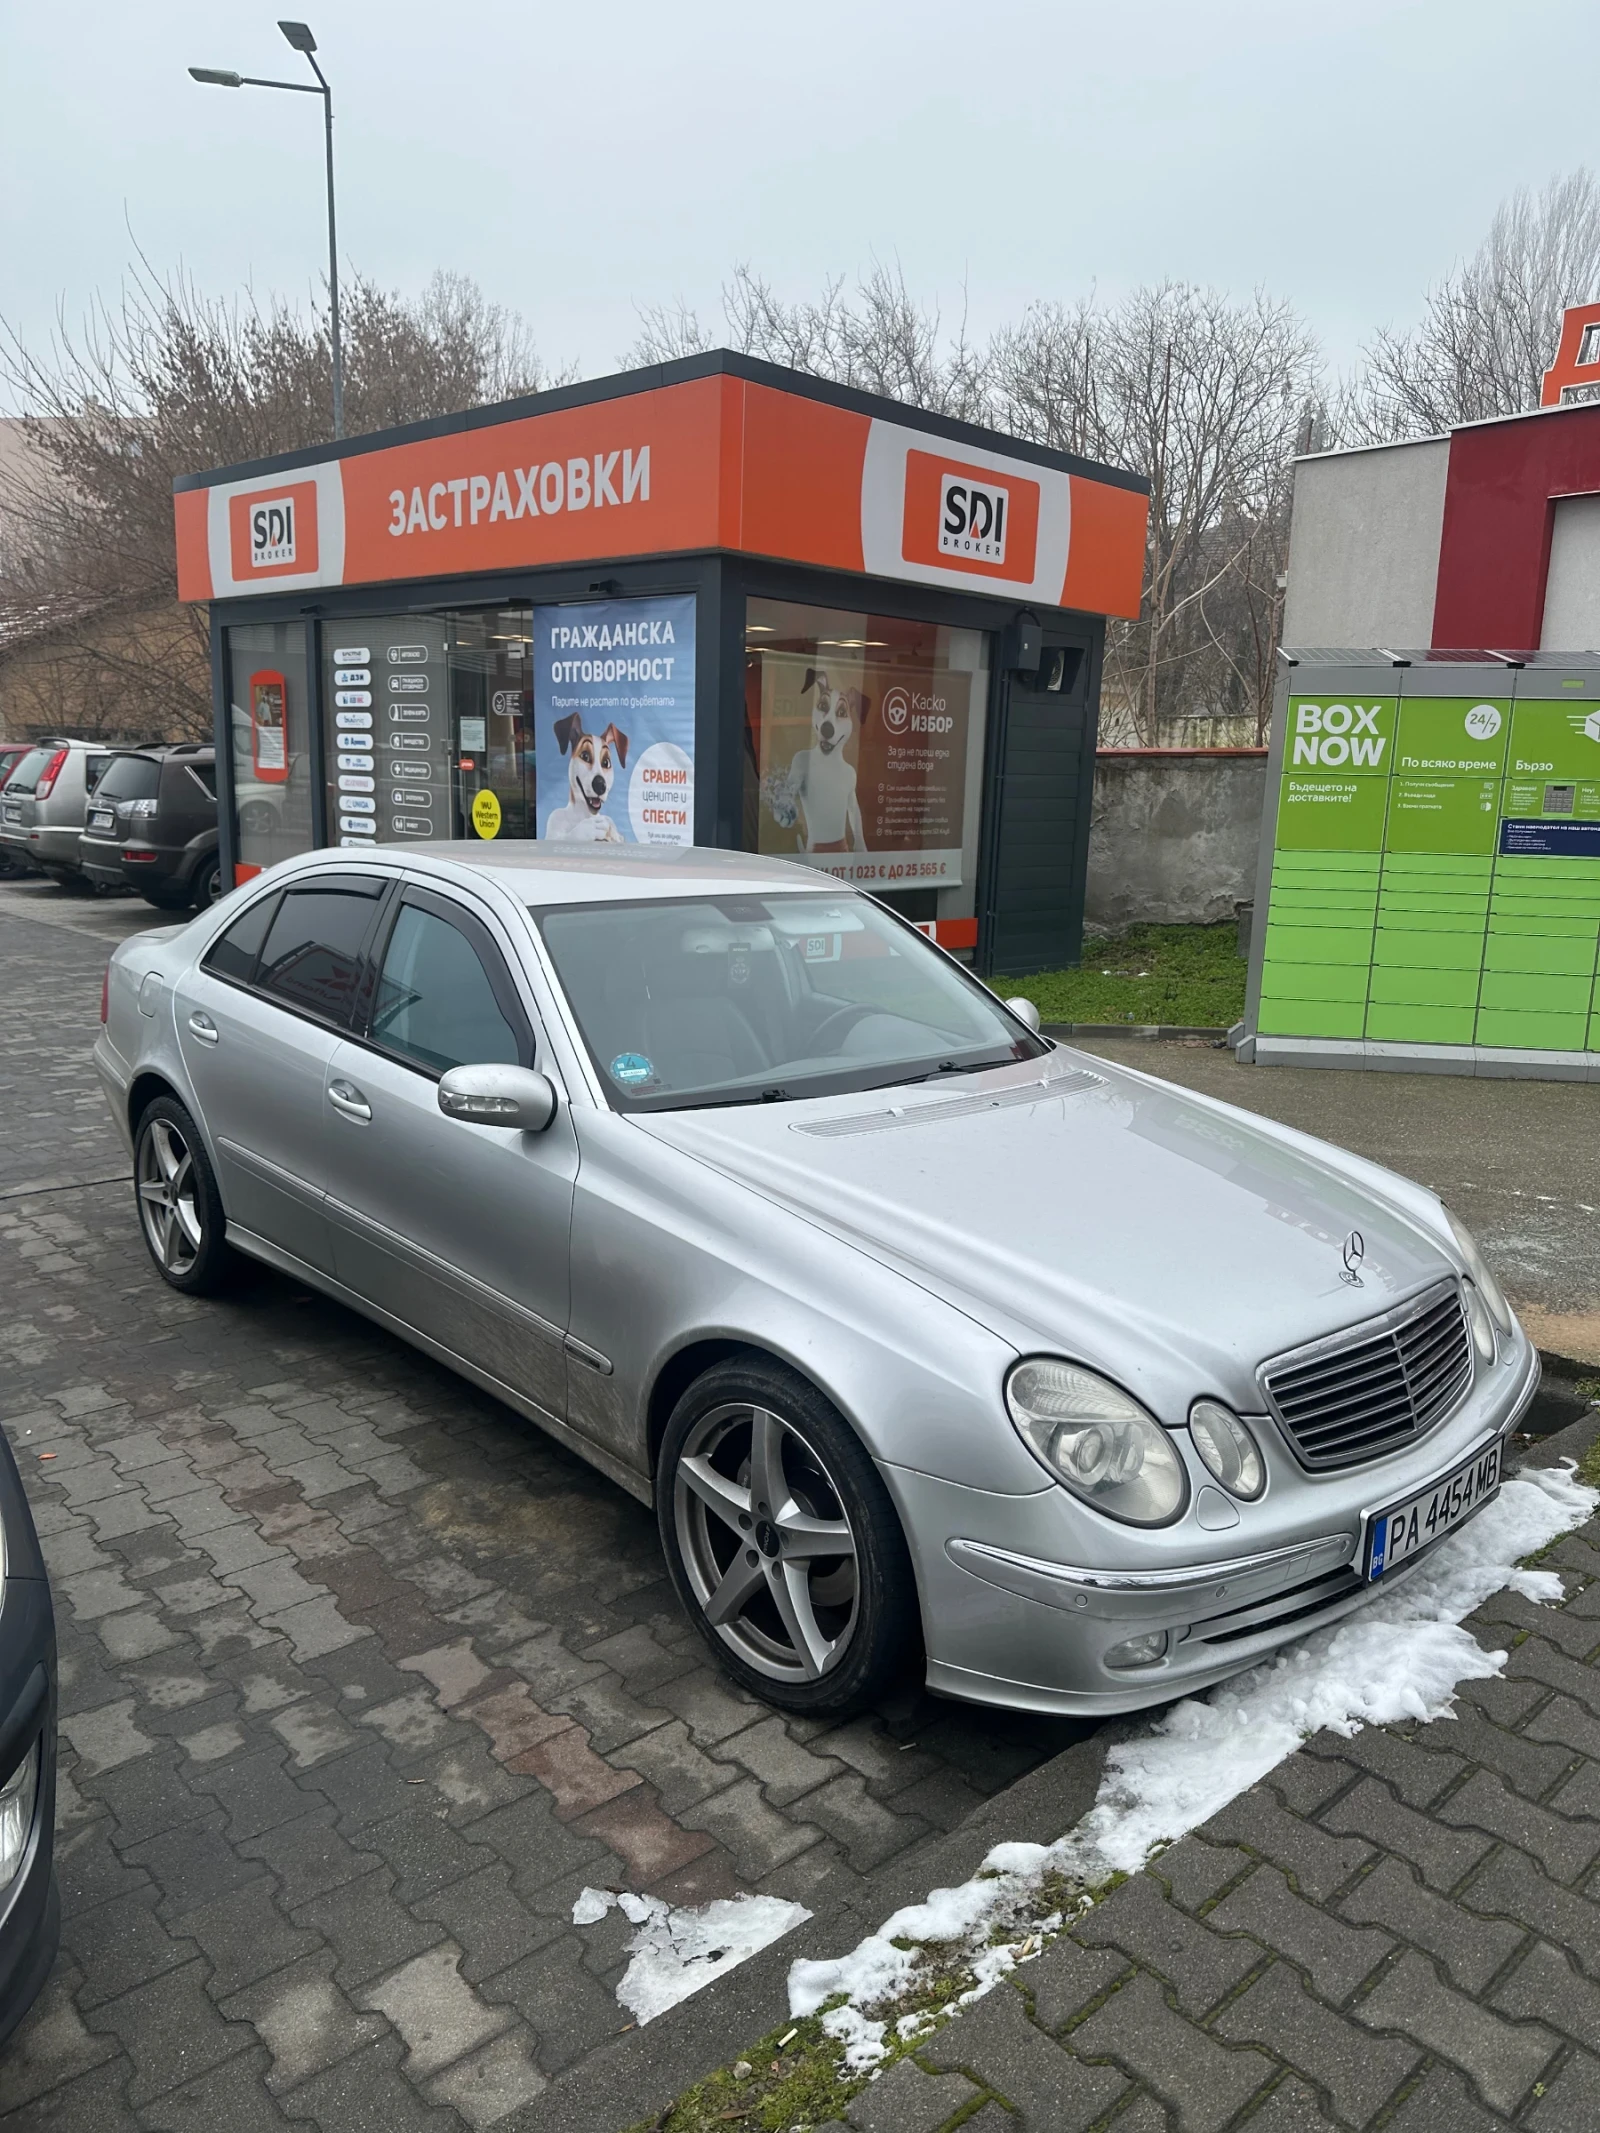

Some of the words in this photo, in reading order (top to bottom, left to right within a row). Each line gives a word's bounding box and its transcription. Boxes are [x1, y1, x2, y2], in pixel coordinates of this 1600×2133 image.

[388, 445, 650, 537] ЗАСТРАХОВКИ
[944, 485, 1004, 543] SDI
[253, 506, 292, 549] SDI
[943, 536, 1000, 556] BROKER
[254, 548, 293, 562] BROKER
[551, 620, 675, 651] ГРАЖДАНСКА
[551, 658, 675, 683] ОТГОВОРНОСТ
[552, 696, 578, 708] Парите
[580, 697, 588, 706] не
[590, 696, 619, 708] растат
[620, 697, 630, 706] по
[630, 695, 675, 708] дърветата
[912, 692, 946, 712] Каско
[911, 715, 953, 734] ИЗБОР
[1296, 704, 1382, 735] BOX
[1469, 713, 1497, 734] 24/7
[888, 746, 897, 756] За
[898, 748, 906, 759] да
[906, 748, 914, 756] не
[916, 749, 934, 758] пиеш
[935, 749, 950, 759] една
[1292, 736, 1386, 766] NOW
[888, 761, 916, 772] студена
[918, 760, 934, 772] вода
[1402, 757, 1419, 769] По
[1421, 758, 1456, 769] всяко
[1458, 760, 1497, 771] време
[1515, 760, 1554, 772] Бързо
[642, 769, 687, 784] СРАВНИ
[1289, 782, 1342, 792] Бъдещето
[1344, 784, 1357, 792] на
[642, 790, 679, 802] цените
[680, 793, 687, 803] и
[1288, 794, 1352, 802] доставките!
[480, 802, 492, 810] WU
[476, 810, 498, 820] Western
[642, 809, 687, 825] СПЕСТИ
[479, 819, 495, 828] Union
[832, 866, 846, 880] ОТ
[849, 866, 854, 879] 1
[857, 865, 876, 879] 023
[879, 864, 886, 878] €
[888, 864, 904, 880] ДО
[906, 864, 917, 876] 25
[920, 862, 937, 876] 565
[940, 862, 946, 875] €
[1389, 1506, 1419, 1560] PA
[1425, 1468, 1474, 1534] 4454
[1475, 1448, 1498, 1500] MB
[1372, 1553, 1384, 1569] BG
